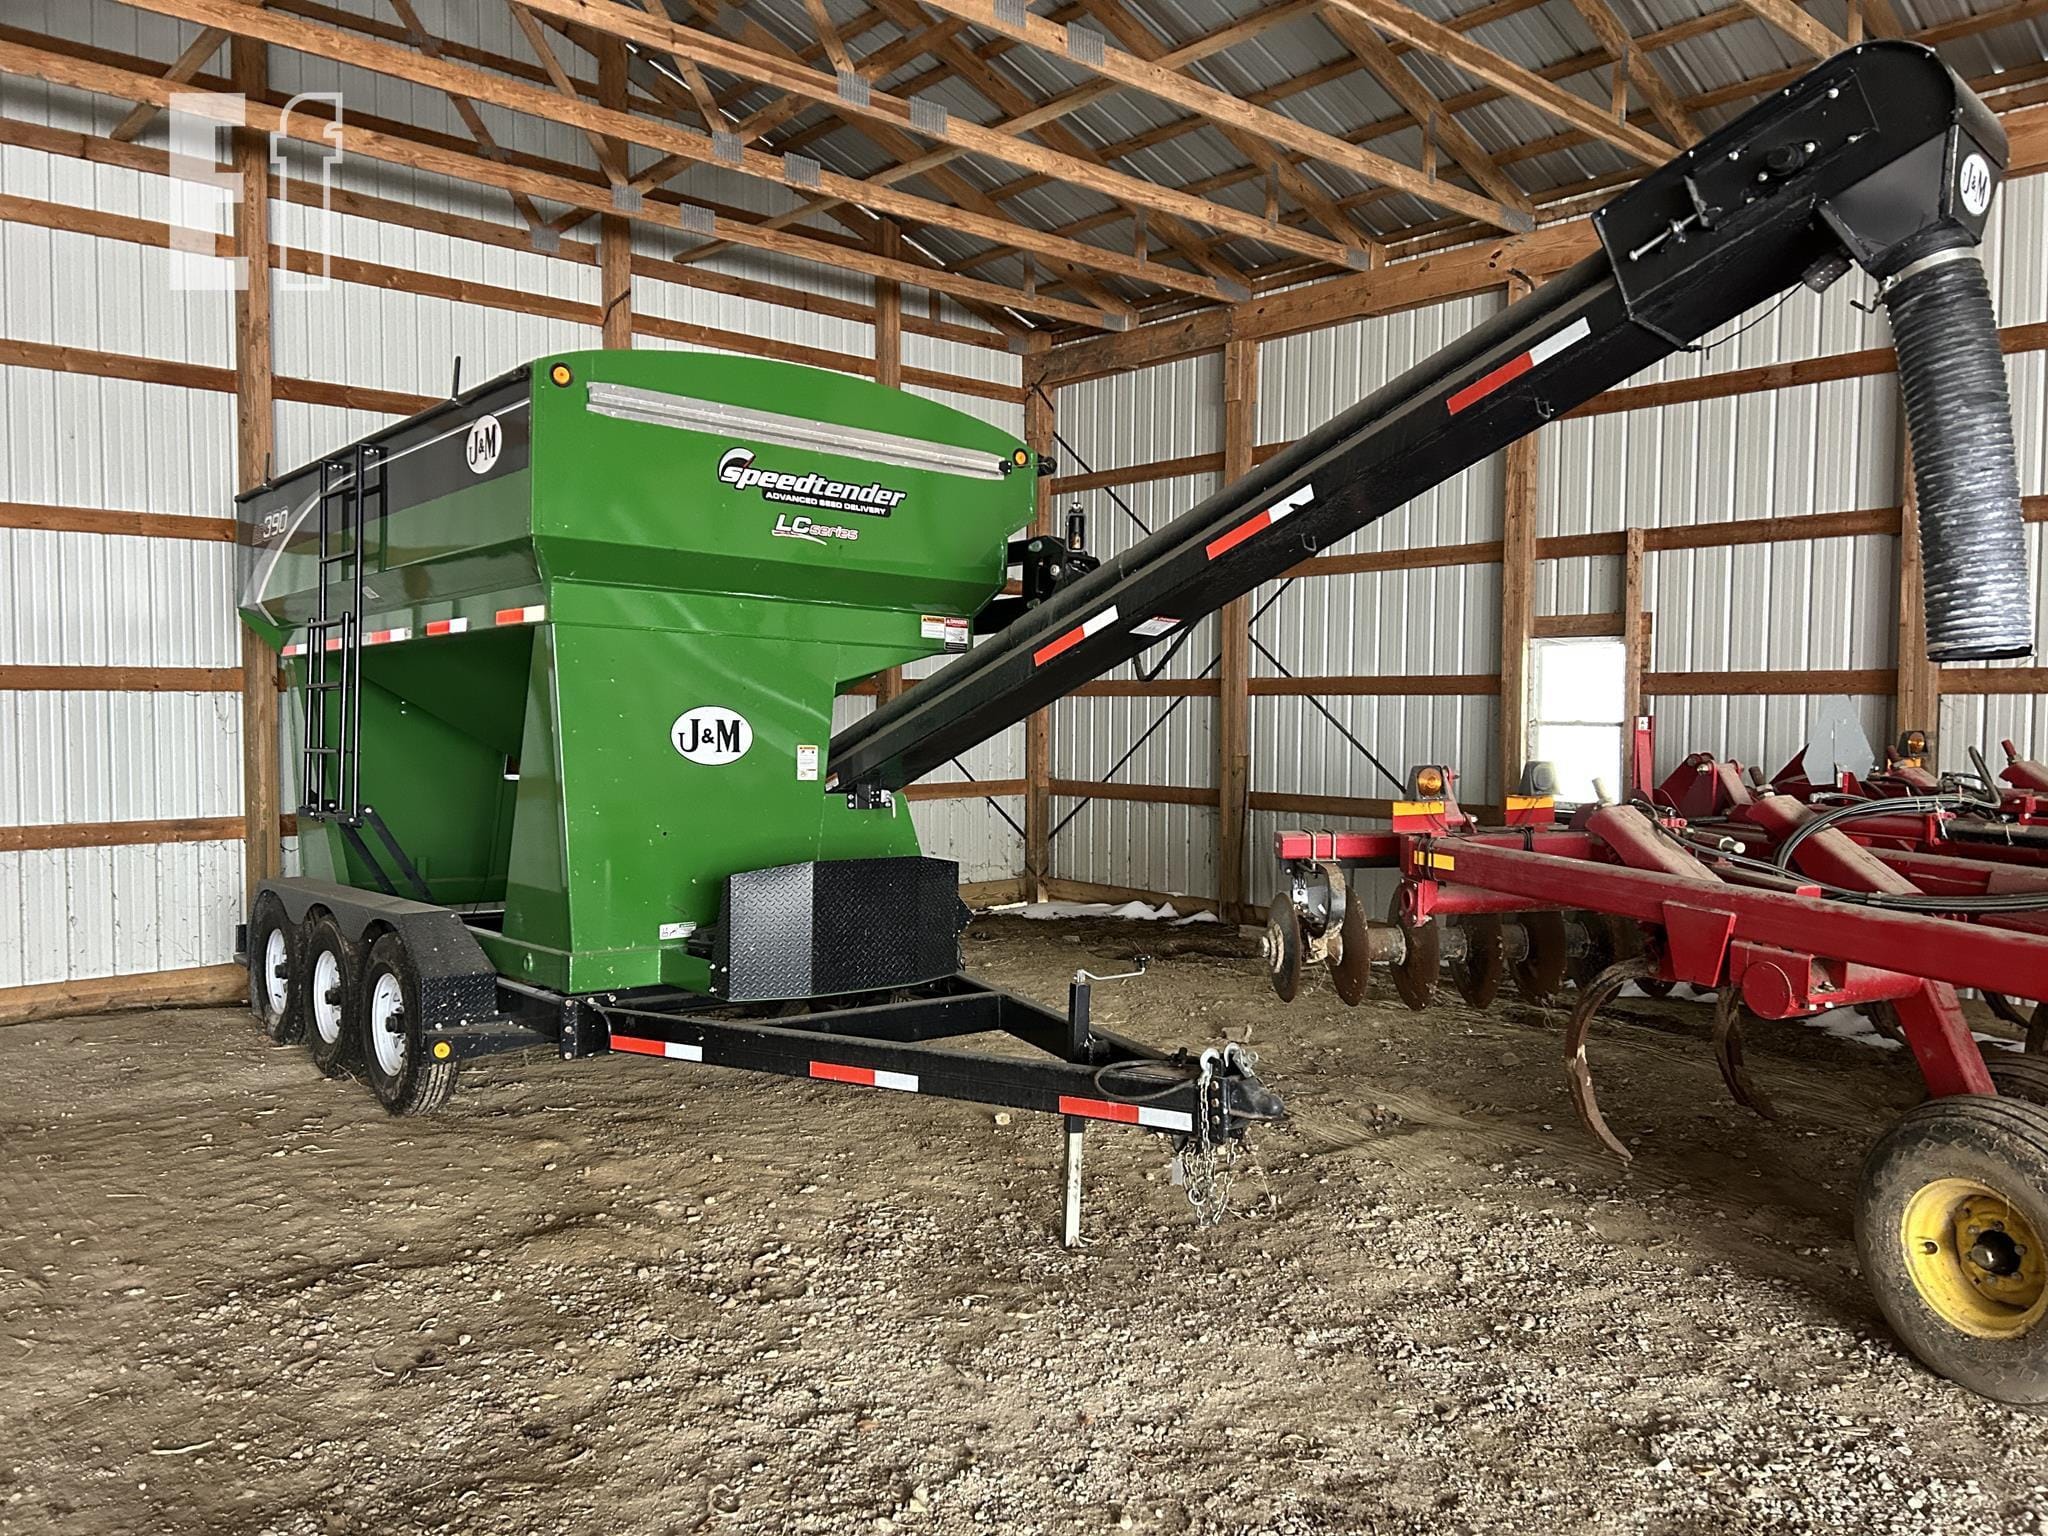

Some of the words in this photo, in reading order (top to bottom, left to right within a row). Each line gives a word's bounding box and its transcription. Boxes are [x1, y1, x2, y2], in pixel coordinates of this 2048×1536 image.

[1963, 162, 1988, 208] J&M
[469, 423, 497, 465] J&M
[765, 491, 818, 505] ADVANCED
[818, 499, 843, 509] SEED
[843, 503, 886, 515] DELIVERY
[263, 509, 288, 538] 390
[678, 719, 741, 753] J&M
